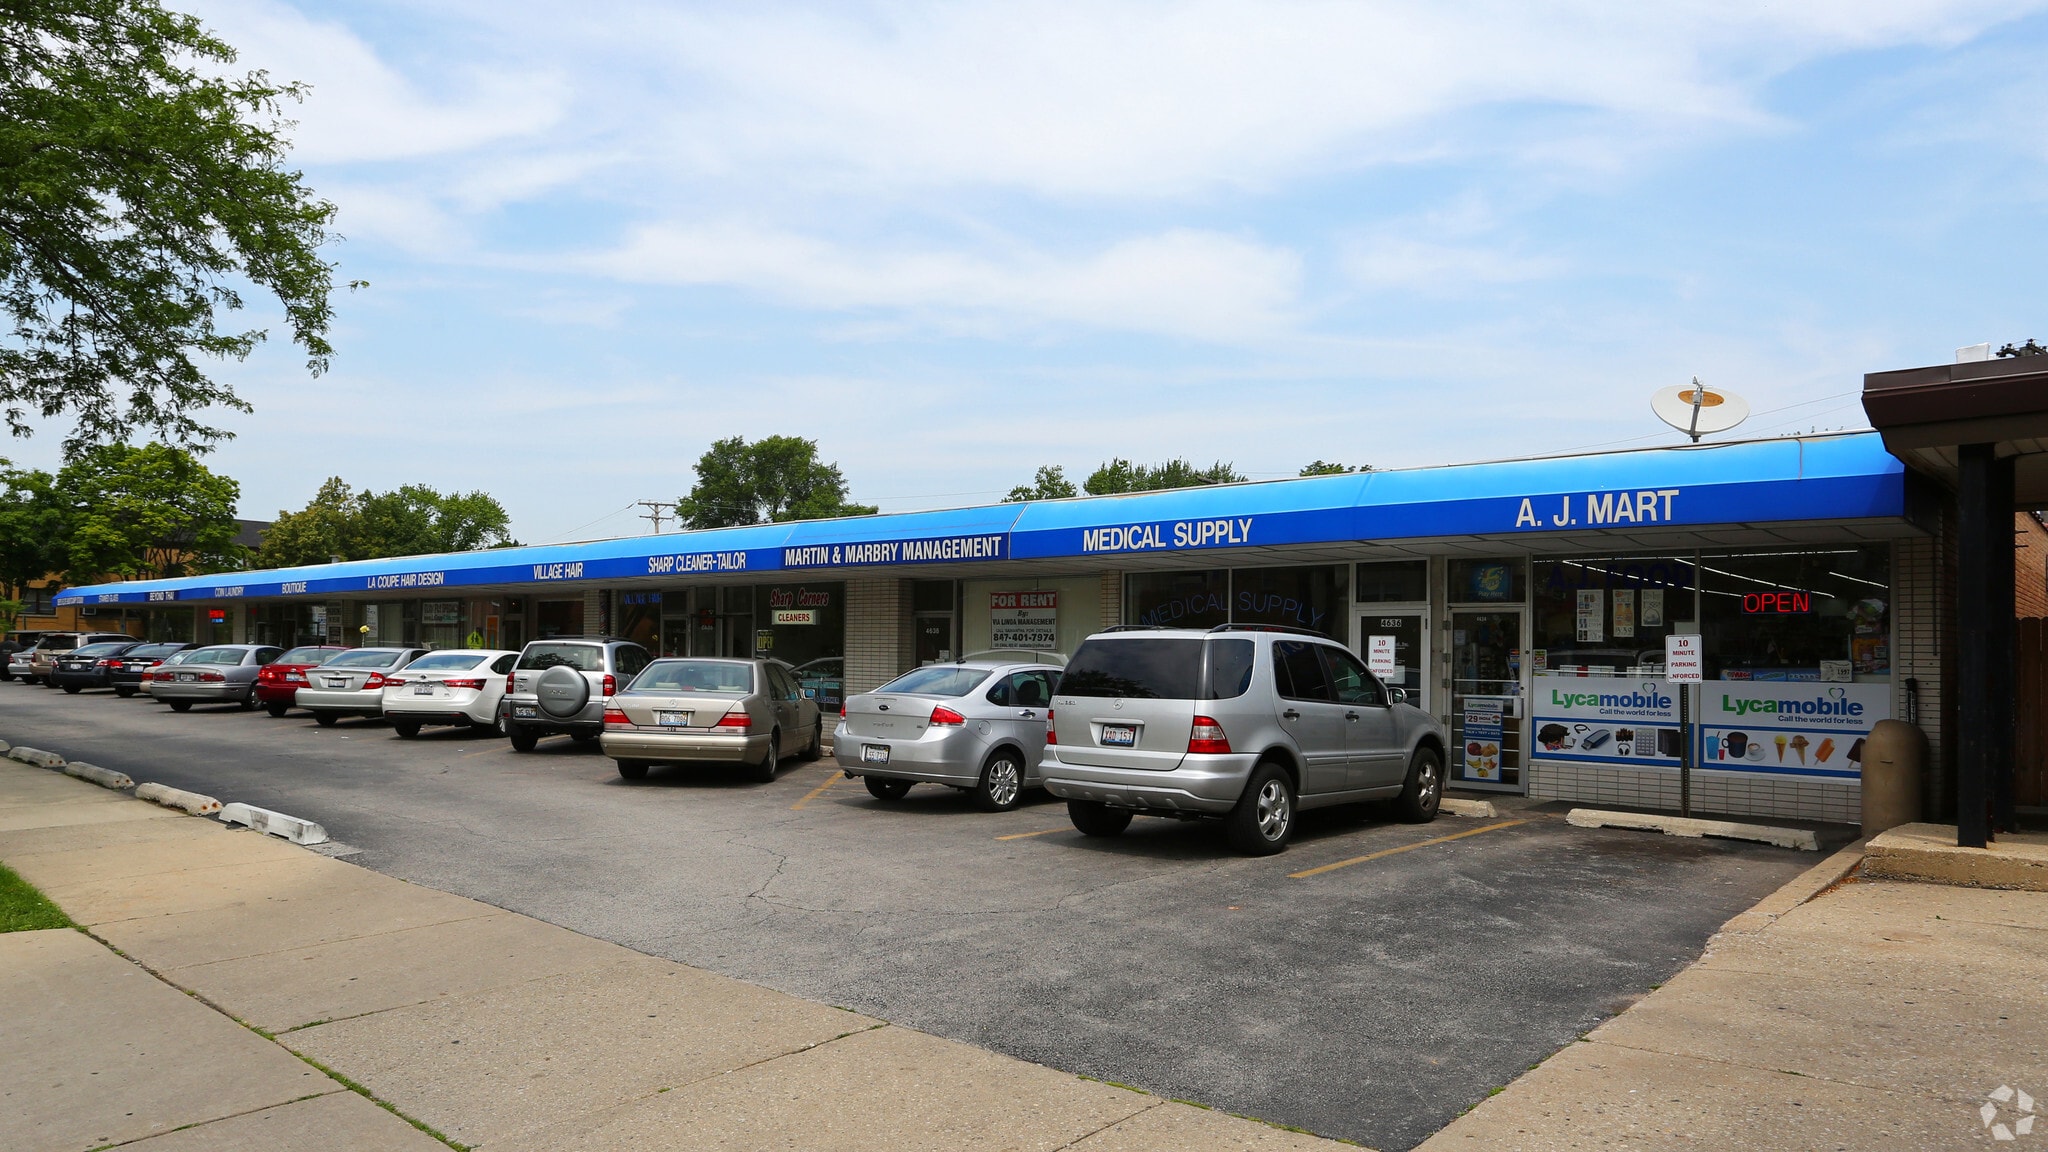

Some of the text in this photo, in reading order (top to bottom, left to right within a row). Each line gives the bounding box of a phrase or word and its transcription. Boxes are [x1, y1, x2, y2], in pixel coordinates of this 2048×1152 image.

[1516, 489, 1679, 528] A. J. MART
[1083, 518, 1253, 552] MEDICAL SUPPLY
[785, 535, 1002, 567] MARTIN & MARBRY MANAGEMENT
[533, 562, 583, 580] VILLAGE HAIR
[648, 551, 746, 574] SHARP CLEANER-TAILOR
[282, 581, 307, 595] BOUTIQUE
[367, 571, 444, 588] LA COUPE HAIR DESIGN
[149, 591, 175, 601] BEYOND THAI
[214, 586, 245, 598] COIN LAUNDRY
[770, 586, 829, 610] Sharp Corners
[992, 593, 1056, 607] FOR RENT
[1140, 591, 1326, 627] MEDICAL SUPPLY
[1743, 592, 1809, 613] OPEN
[778, 613, 810, 622] CLEANERS
[1017, 609, 1029, 618] By:
[1381, 618, 1402, 627] 4636
[993, 633, 1055, 642] 847-401-7974
[1678, 639, 1689, 648] 10
[1552, 688, 1672, 709] Lycamobile
[1722, 694, 1864, 716] Lycamobile
[1794, 715, 1808, 723] the
[1809, 716, 1832, 724] world
[1833, 716, 1846, 724] for
[1846, 717, 1863, 725] less
